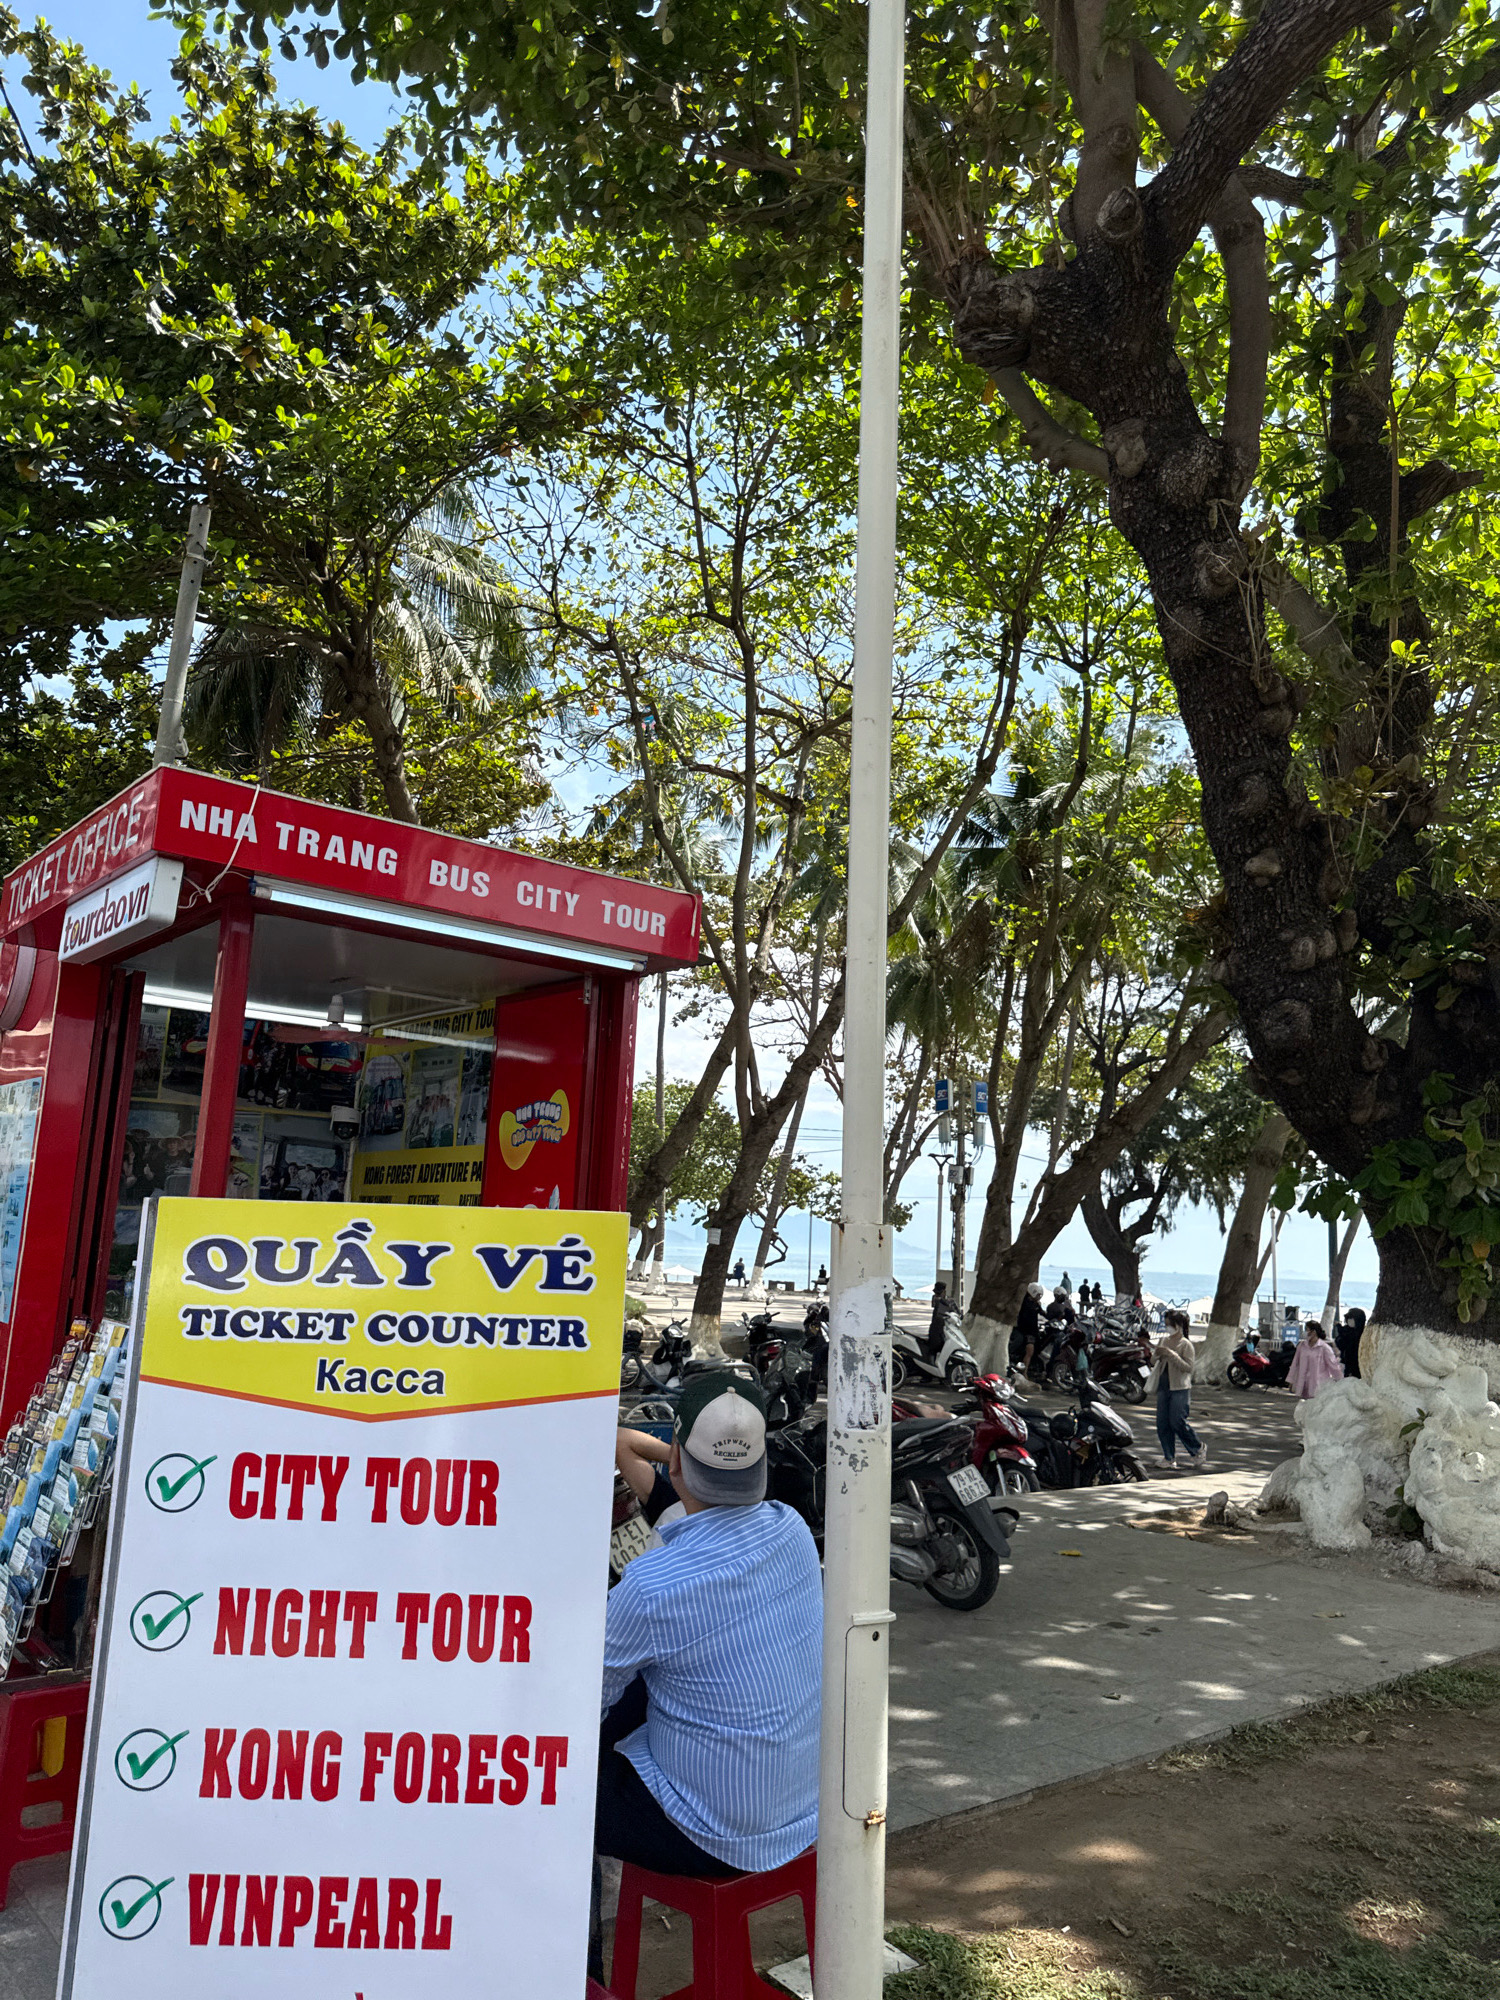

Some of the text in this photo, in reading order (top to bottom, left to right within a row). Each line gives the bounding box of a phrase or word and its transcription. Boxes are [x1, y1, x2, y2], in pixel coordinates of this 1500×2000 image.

[8, 792, 144, 921] TICKET OFFICE
[180, 799, 666, 938] NHA TRANG BUS CITY TOUR
[63, 882, 150, 953] tourdao.vn
[451, 1012, 474, 1033] CITY
[475, 1007, 495, 1030] TOU
[364, 1161, 483, 1184] KONG FOREST ADVENTURE PA
[185, 1221, 593, 1291] QUẦY VÉ
[183, 1308, 588, 1347] TICKET COUNTER
[316, 1359, 444, 1394] Касса
[712, 1438, 751, 1451] TRIPWEAR
[713, 1450, 748, 1458] RECKLESS
[229, 1453, 499, 1526] CITY TOUR
[213, 1587, 532, 1662] NIGHT TOUR
[199, 1728, 569, 1805] KONG FOREST
[188, 1874, 453, 1950] VINPEARL
